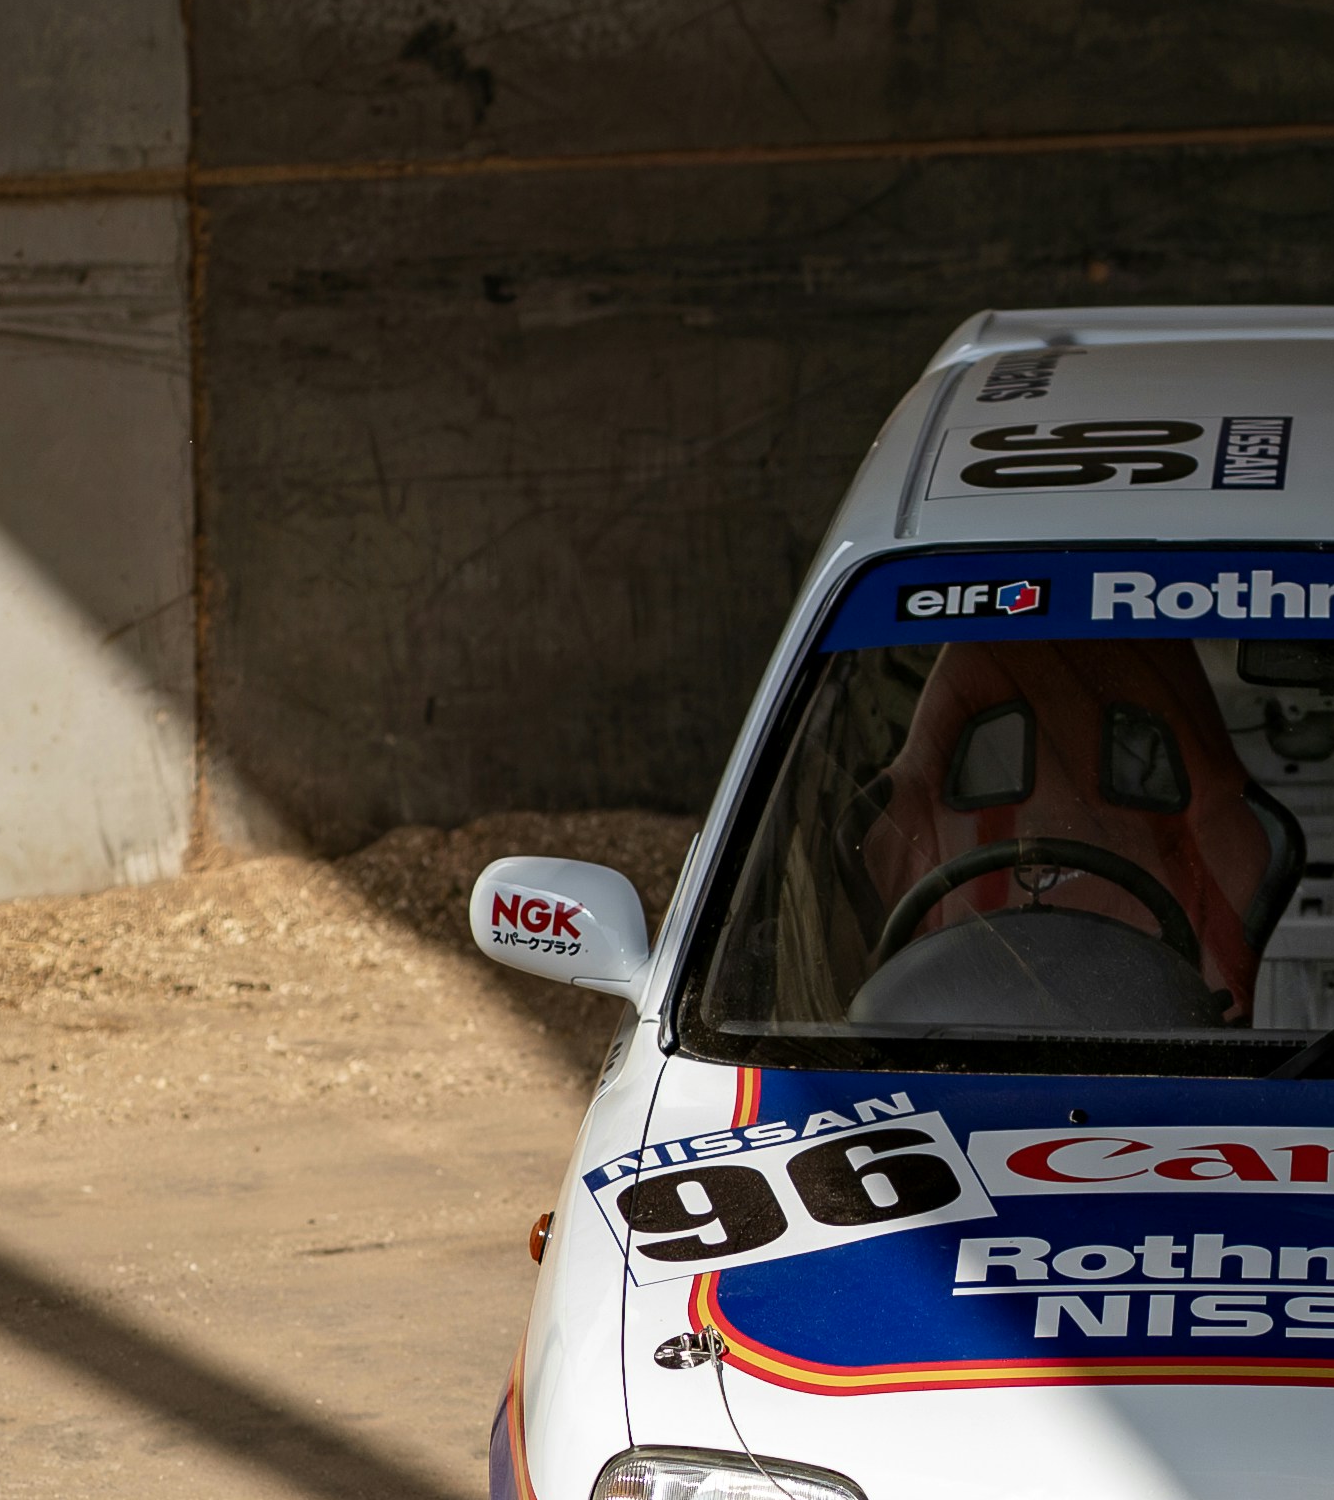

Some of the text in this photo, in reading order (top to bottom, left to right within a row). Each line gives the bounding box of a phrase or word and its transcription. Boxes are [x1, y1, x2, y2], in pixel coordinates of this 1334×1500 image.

[960, 420, 1204, 488] 96
[1221, 418, 1284, 485] NISSAN
[907, 585, 989, 616] elf
[492, 891, 585, 940] NGK
[492, 930, 582, 957] スパークプラグ
[603, 1091, 916, 1180] NISSAN
[616, 1127, 962, 1262] 96
